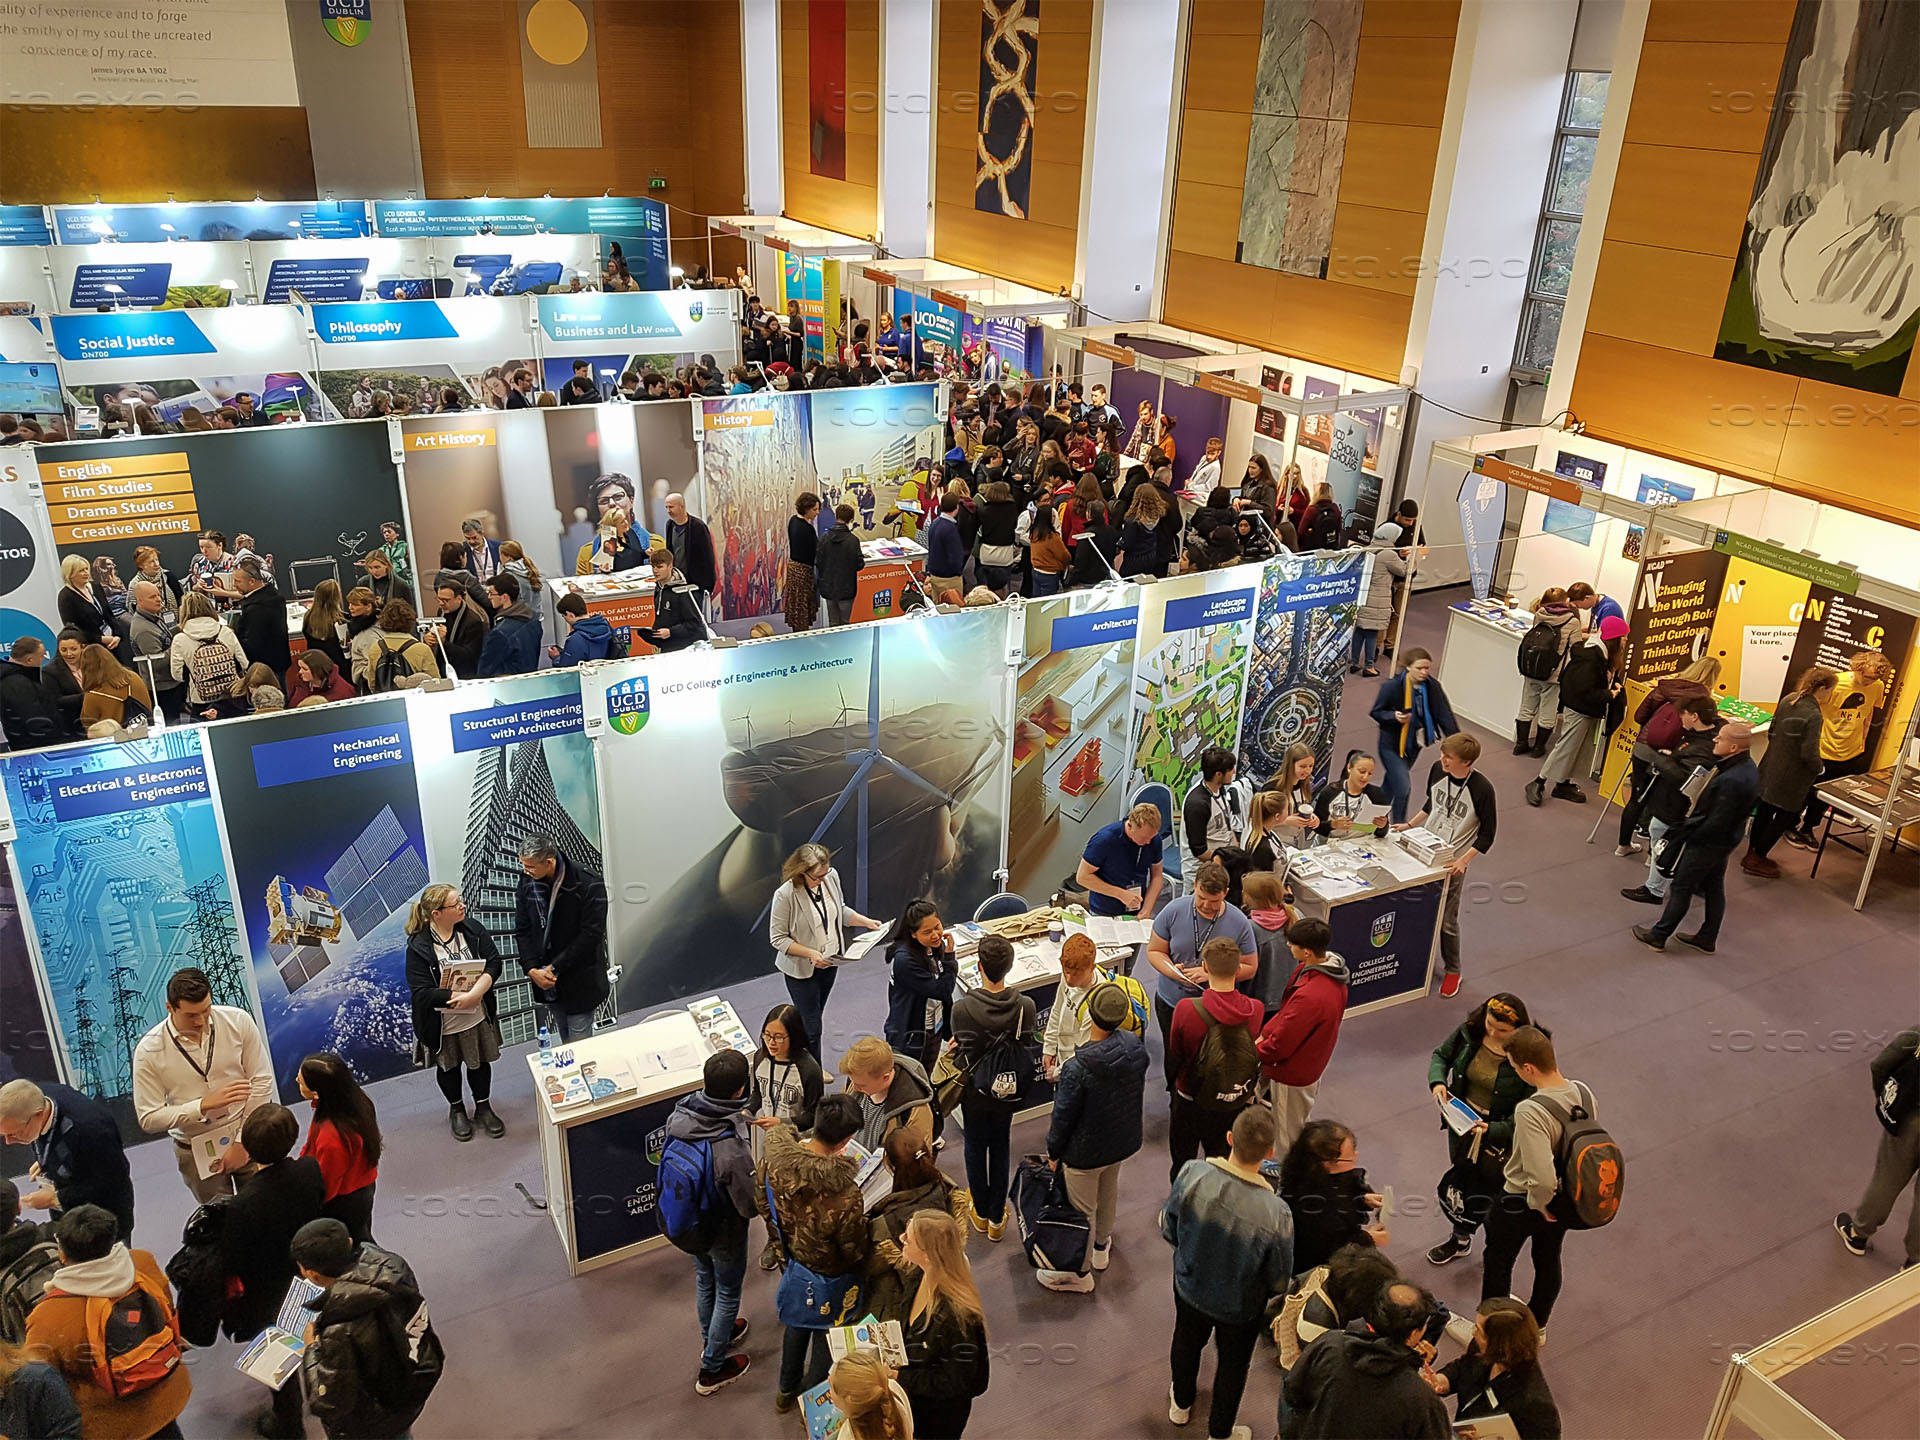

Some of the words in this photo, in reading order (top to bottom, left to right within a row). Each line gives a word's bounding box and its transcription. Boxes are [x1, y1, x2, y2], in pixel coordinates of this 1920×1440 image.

[30, 4, 42, 17] of
[46, 8, 112, 20] experience
[117, 9, 138, 20] and
[142, 11, 154, 20] to
[157, 10, 188, 23] forge
[22, 25, 62, 39] smithy
[66, 28, 79, 39] of
[83, 29, 100, 39] my
[104, 28, 128, 39] soul
[131, 30, 150, 40] the
[154, 30, 212, 41] uncreated
[21, 46, 88, 57] conscience
[92, 47, 104, 59] of
[107, 49, 125, 59] my
[128, 49, 157, 58] race.
[554, 312, 576, 322] Law
[915, 311, 936, 327] UCD
[329, 319, 402, 338] Philosophy
[555, 325, 605, 337] Business
[608, 324, 628, 335] and
[631, 323, 652, 334] Law
[79, 336, 123, 350] Social
[127, 334, 175, 349] Justice
[82, 351, 109, 359] DN700
[713, 415, 752, 426] History
[416, 436, 436, 447] Art
[438, 433, 486, 446] History
[1337, 441, 1359, 461] CHORAL
[57, 462, 113, 480] English
[1575, 467, 1594, 481] PEER
[62, 485, 96, 499] Film
[100, 480, 153, 496] Studies
[1647, 488, 1678, 502] PEER
[67, 504, 118, 519] Drama
[120, 499, 175, 515] Studies
[71, 522, 134, 539] Creative
[135, 518, 191, 535] Writing
[1647, 560, 1665, 571] NCAD
[1736, 541, 1752, 550] NCAD
[1809, 564, 1819, 572] Art
[1825, 569, 1849, 581] Design)
[1306, 582, 1319, 593] City
[1321, 578, 1350, 590] Planning
[1637, 571, 1664, 609] N
[1656, 580, 1706, 597] Changing
[1725, 584, 1744, 604] N
[1211, 597, 1247, 609] Landscape
[1286, 590, 1334, 603] Environmental
[1335, 586, 1356, 598] Policy
[1203, 605, 1246, 618] Architecture
[1652, 601, 1671, 613] the
[1672, 594, 1705, 610] World
[1806, 598, 1825, 621] N
[1649, 611, 1691, 629] through
[1789, 602, 1805, 623] C
[1092, 617, 1138, 632] Architecture
[1645, 630, 1666, 644] and
[1867, 626, 1885, 648] C
[1643, 642, 1690, 660] Thinking,
[661, 684, 684, 694] UCD
[686, 677, 722, 692] College
[724, 674, 735, 685] of
[736, 666, 788, 684] Engineering
[790, 664, 798, 673] &
[799, 656, 854, 672] Architecture
[1638, 659, 1678, 675] Making
[611, 692, 646, 707] UCD
[463, 713, 518, 731] Structural
[521, 704, 582, 721] Engineering
[613, 704, 645, 714] DUBLIN
[491, 727, 516, 740] with
[518, 717, 583, 735] Architecture
[333, 733, 400, 753] Mechanical
[333, 749, 402, 768] Engineering
[59, 778, 121, 798] Electrical
[123, 776, 136, 787] &
[138, 766, 203, 785] Electronic
[130, 781, 206, 801] Engineering
[1375, 923, 1391, 931] UCD
[1352, 962, 1393, 979] ENGINEERING
[1359, 956, 1385, 969] COLLEGE
[1352, 969, 1397, 986] ARCHITECTURE
[649, 1137, 665, 1149] UC
